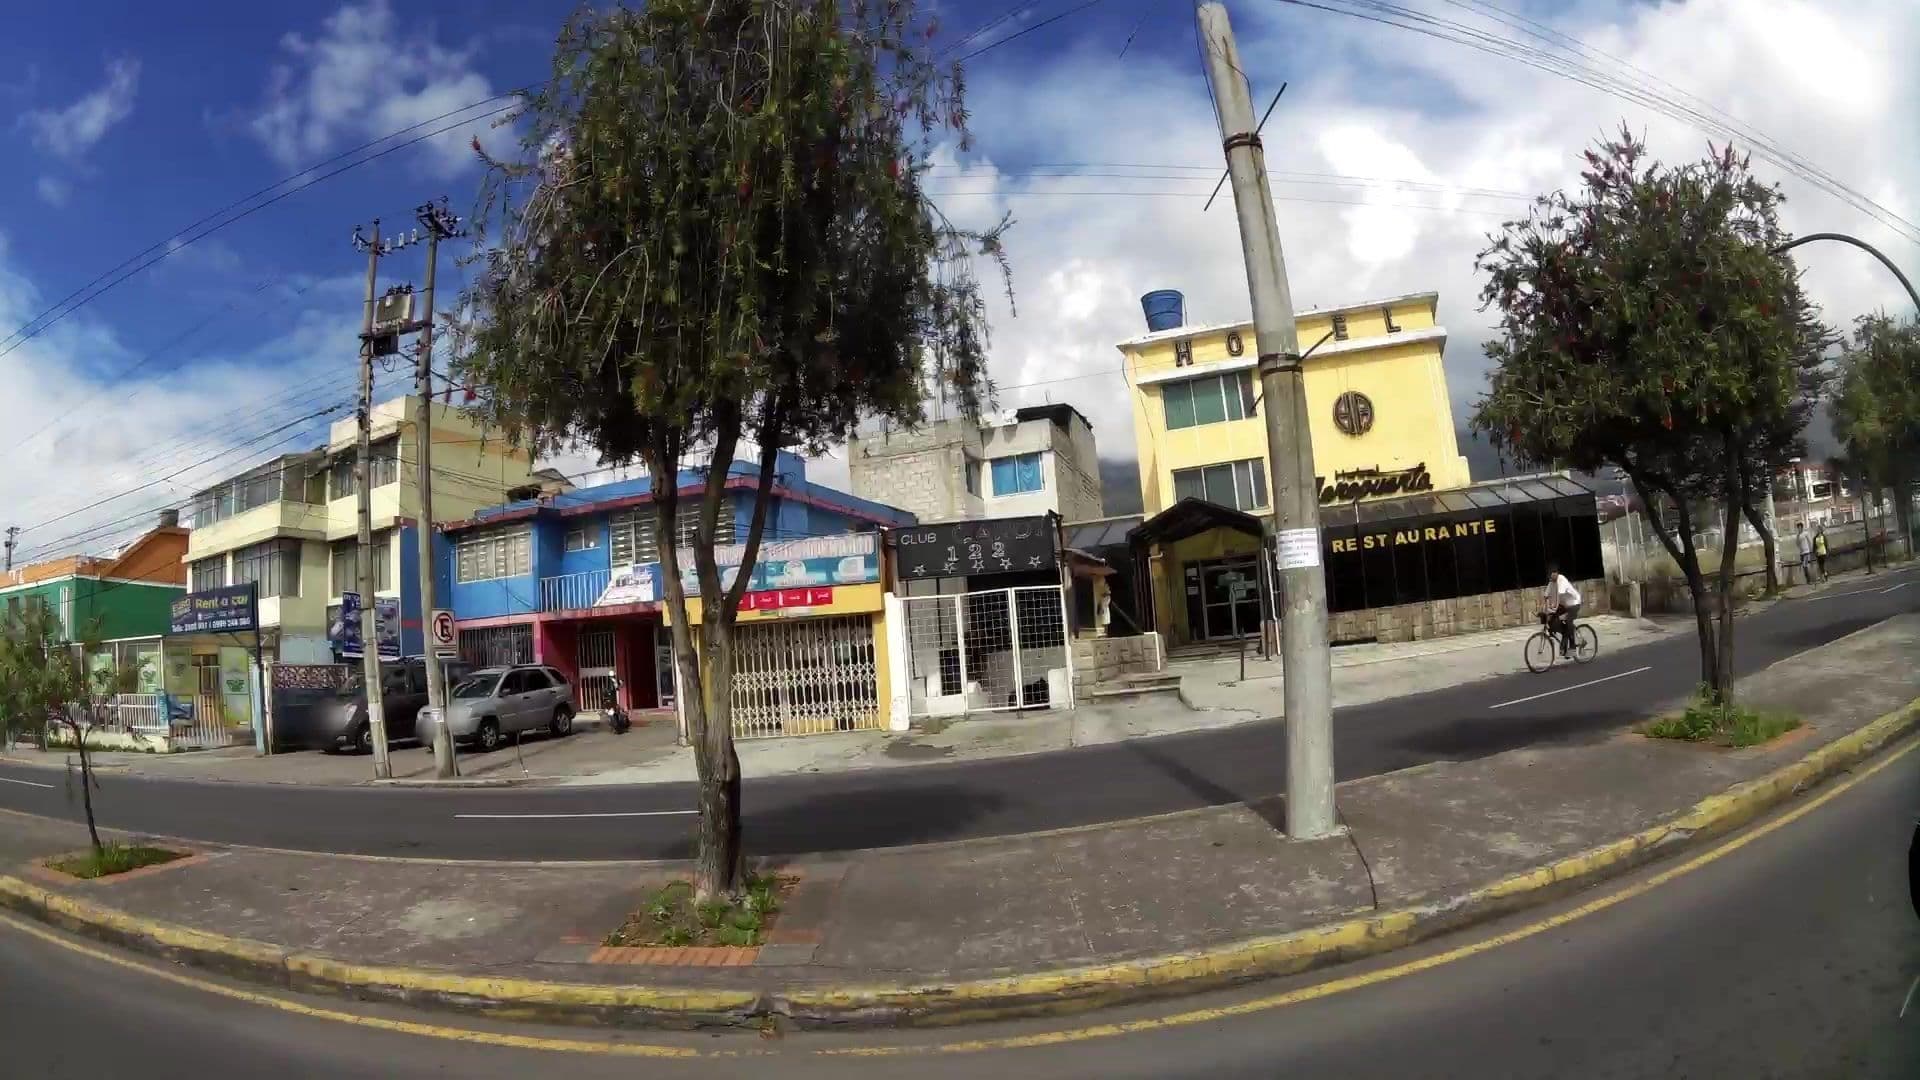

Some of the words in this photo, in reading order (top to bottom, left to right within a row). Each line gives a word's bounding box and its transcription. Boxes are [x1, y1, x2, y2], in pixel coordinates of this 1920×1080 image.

[1175, 304, 1402, 368] HOEL
[900, 532, 937, 545] CLUB
[1332, 519, 1497, 553] RESTAURANTE
[947, 541, 1005, 562] 122
[195, 596, 219, 609] Rent
